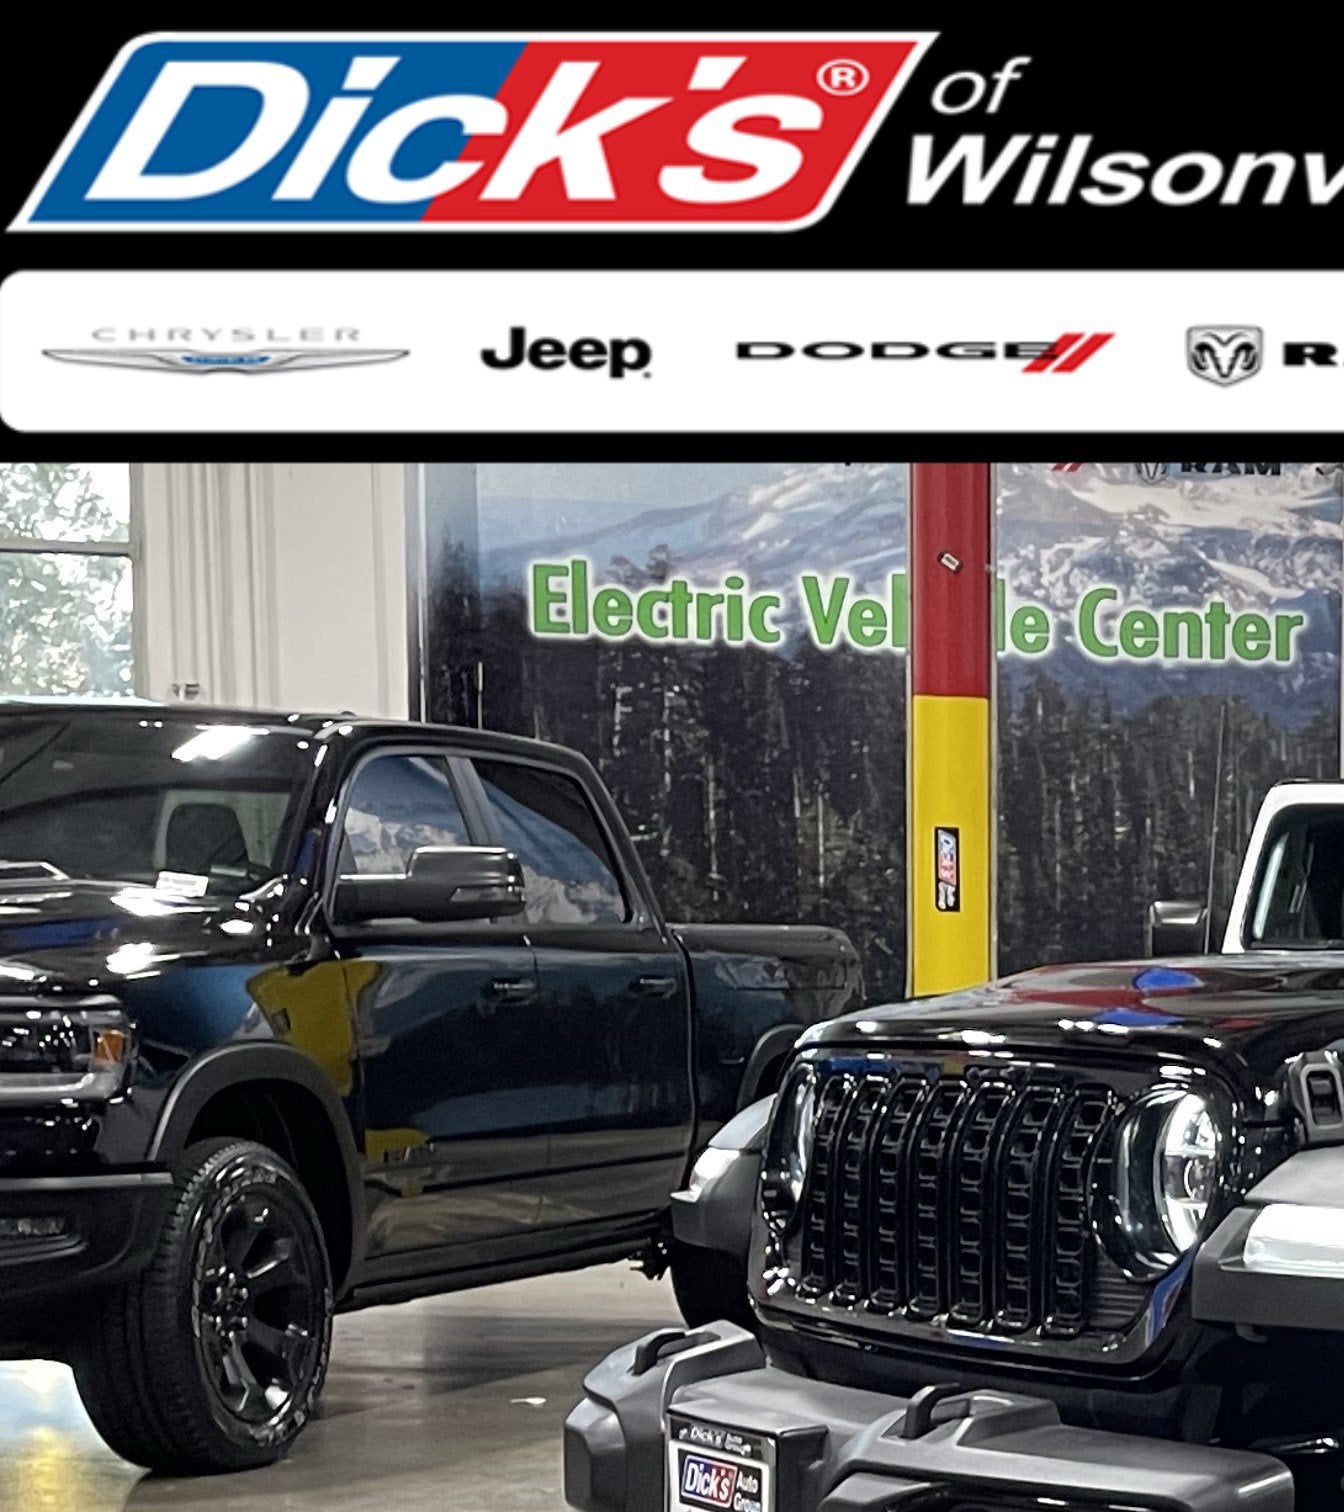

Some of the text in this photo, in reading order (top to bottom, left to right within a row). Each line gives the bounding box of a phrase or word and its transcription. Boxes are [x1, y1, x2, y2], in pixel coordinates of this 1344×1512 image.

[532, 559, 1304, 662] Electric Vele Center
[685, 1462, 731, 1501] Dick's
[736, 1470, 759, 1494] Auto
